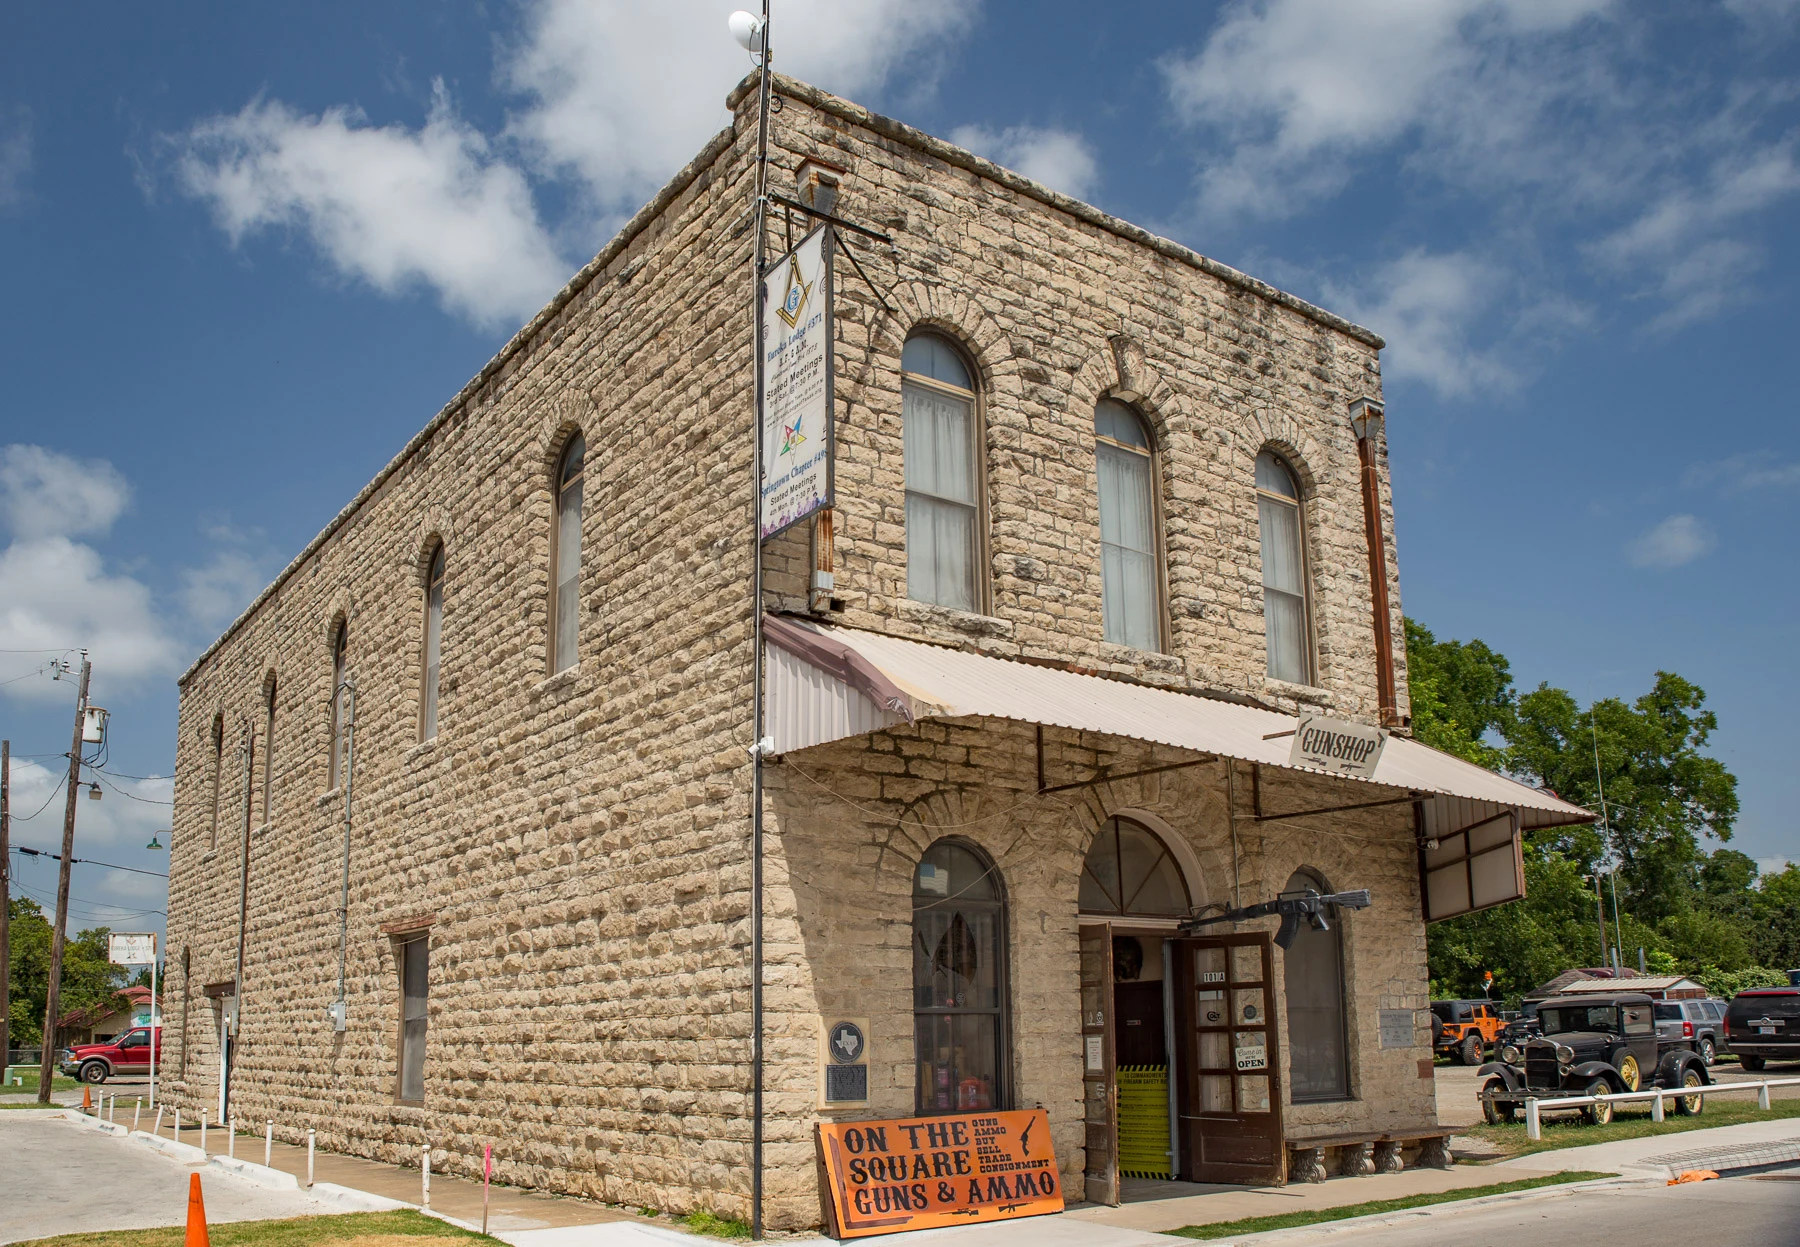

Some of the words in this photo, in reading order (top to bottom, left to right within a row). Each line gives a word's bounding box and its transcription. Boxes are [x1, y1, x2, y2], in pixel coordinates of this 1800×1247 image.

[787, 286, 800, 313] G
[768, 341, 787, 362] Eureka
[788, 327, 806, 346] Lodge
[807, 312, 822, 330] #371
[766, 378, 788, 401] Stated
[790, 354, 823, 383] Meetings
[762, 474, 790, 499] Springtown
[790, 458, 813, 478] Chapter
[770, 488, 789, 506] Stated
[790, 473, 817, 494] Meetings
[1301, 727, 1376, 763] GUNSHOP
[1204, 973, 1217, 982] 101
[1237, 1059, 1265, 1068] OPEN
[972, 1118, 999, 1128] GUNS
[974, 1127, 1007, 1136] AMMO
[844, 1126, 889, 1154] ON
[898, 1121, 970, 1151] THE
[975, 1137, 996, 1146] BUY
[976, 1145, 1002, 1155] SELL
[849, 1150, 972, 1185] SQUARE
[978, 1153, 1013, 1164] TRADE
[979, 1159, 1050, 1173] CONSIGNMENT
[853, 1183, 929, 1215] GUNS
[937, 1181, 956, 1203] &
[967, 1171, 1056, 1204] AMMO
